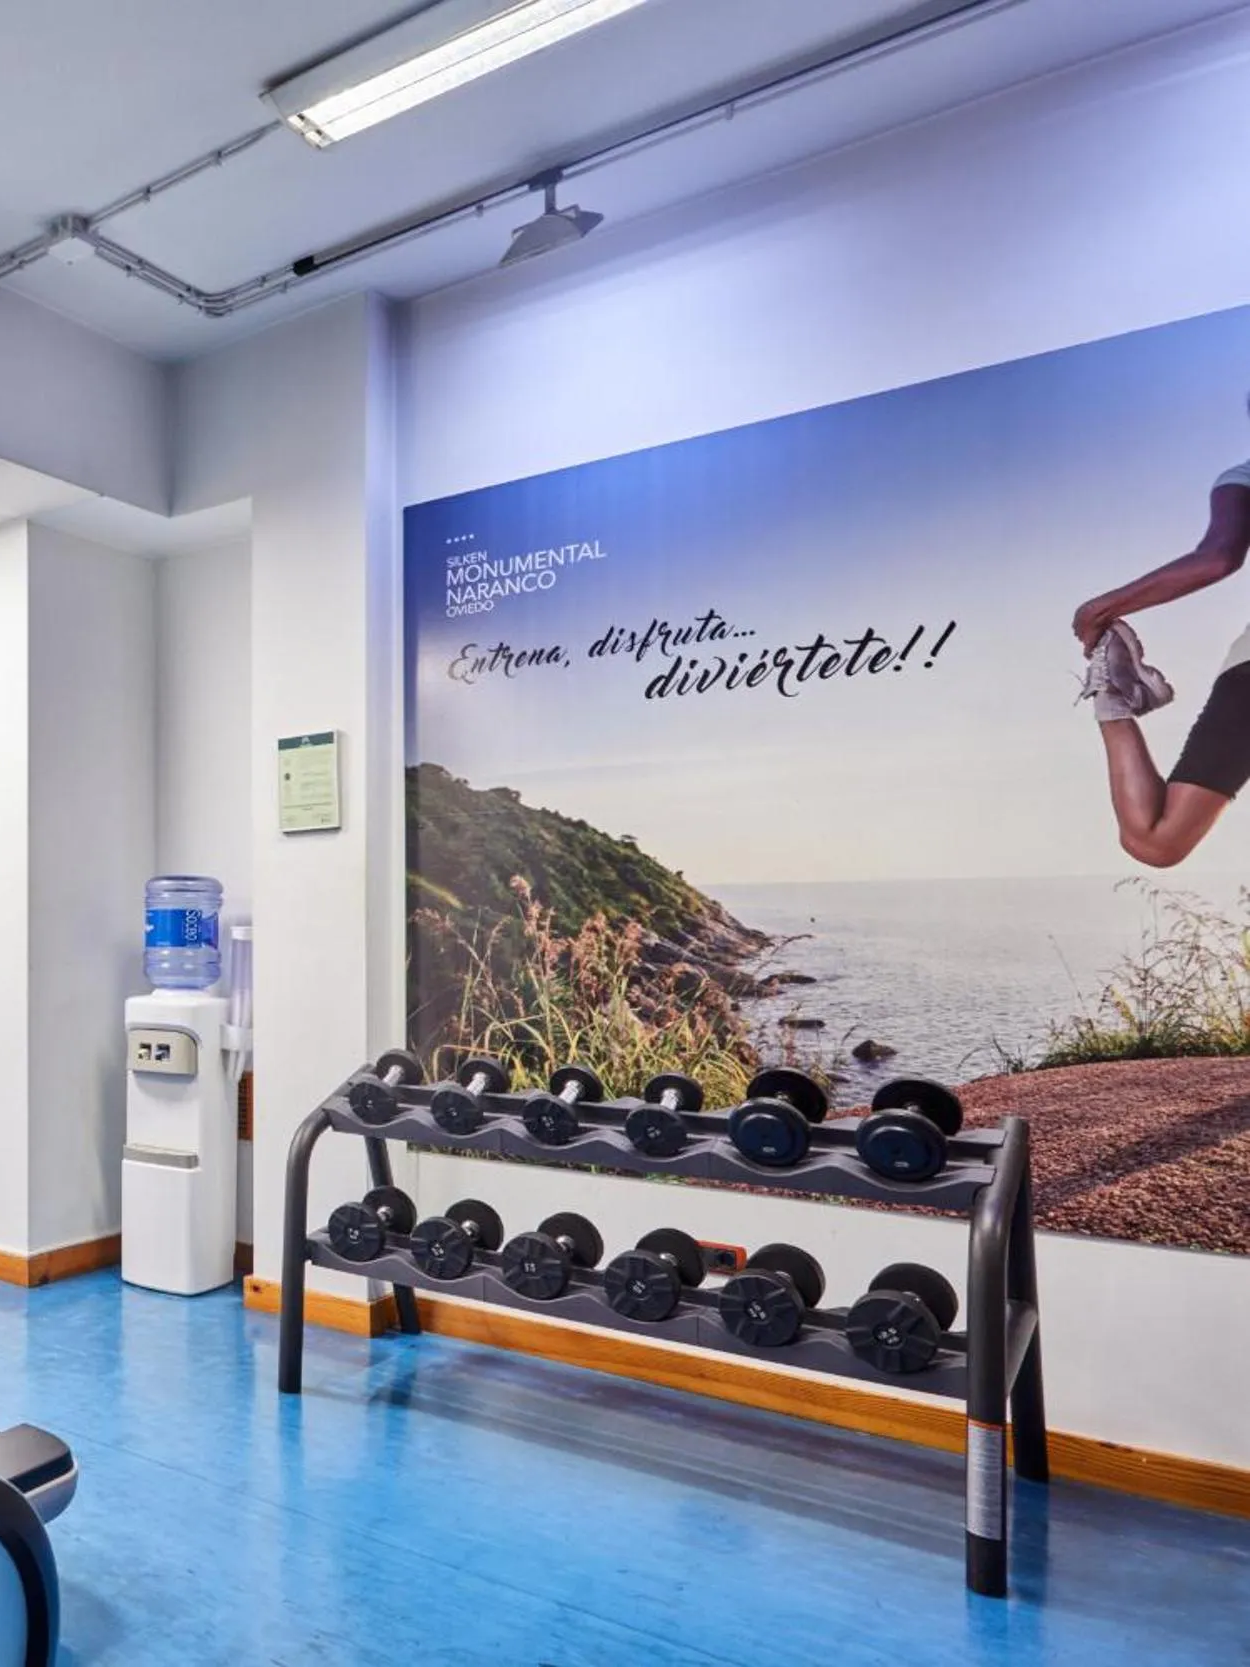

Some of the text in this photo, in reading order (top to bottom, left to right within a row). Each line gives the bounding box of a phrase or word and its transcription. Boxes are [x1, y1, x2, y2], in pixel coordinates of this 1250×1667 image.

[446, 551, 487, 567] SILKEN
[446, 540, 607, 587] MONUMENTAL
[446, 570, 556, 606] NARANCO
[446, 600, 494, 618] OVIEDO
[448, 608, 756, 685] Entrena, disfruta...
[644, 620, 957, 698] diviértete!!
